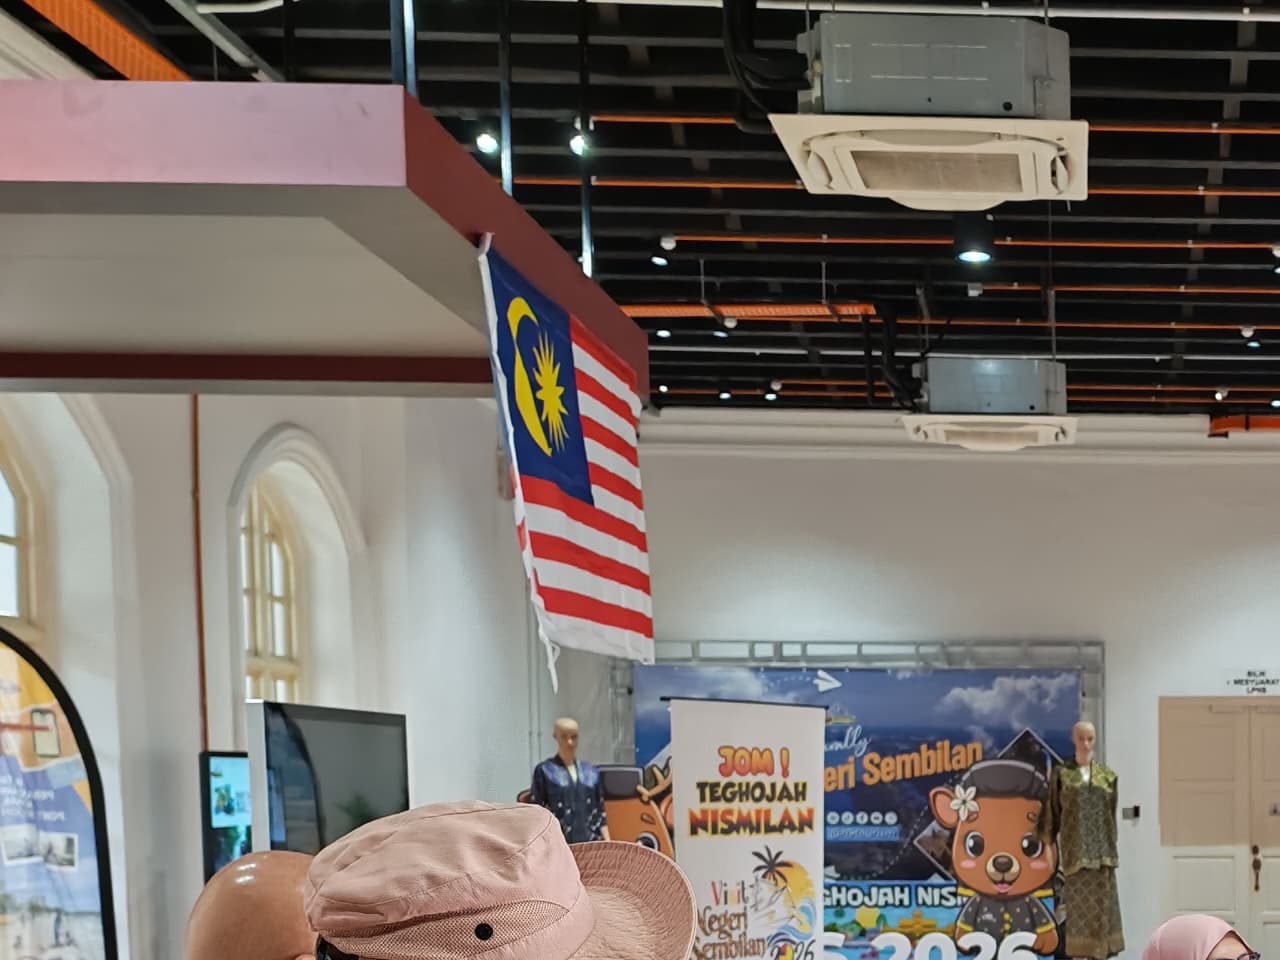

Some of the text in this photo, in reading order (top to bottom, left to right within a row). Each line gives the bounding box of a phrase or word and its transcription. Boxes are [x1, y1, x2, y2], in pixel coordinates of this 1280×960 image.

[718, 745, 790, 778] JOM !
[862, 740, 983, 786] Sembilan
[696, 781, 807, 803] TEGHOJAH
[688, 807, 814, 836] NISMILAN
